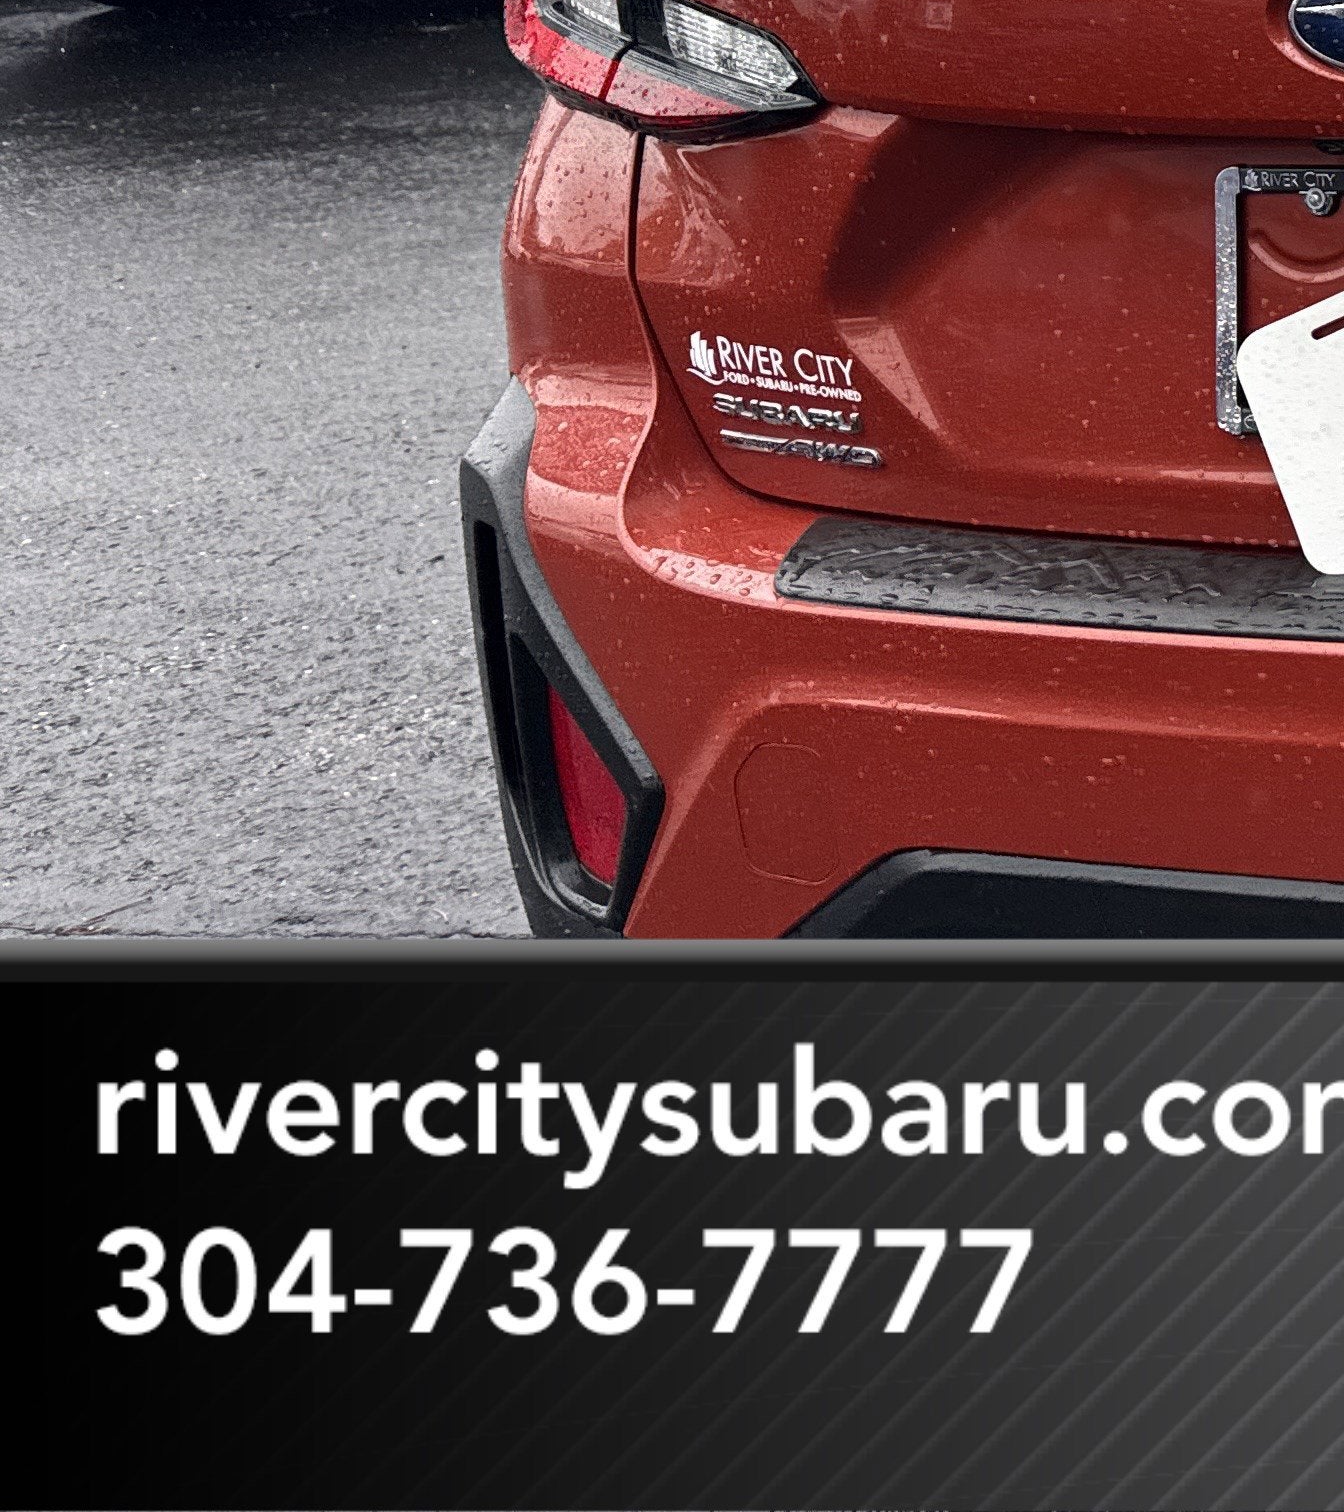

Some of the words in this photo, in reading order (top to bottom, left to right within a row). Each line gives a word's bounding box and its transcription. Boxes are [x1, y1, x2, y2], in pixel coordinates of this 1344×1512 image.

[1261, 171, 1299, 188] RIVER
[1303, 171, 1336, 188] CITY
[716, 335, 787, 378] RIVER
[793, 348, 853, 386] CITY
[723, 370, 750, 386] FORD
[755, 375, 794, 393] SUBARU
[799, 382, 862, 402] PRE-OWNED
[712, 392, 861, 433] SUBARU
